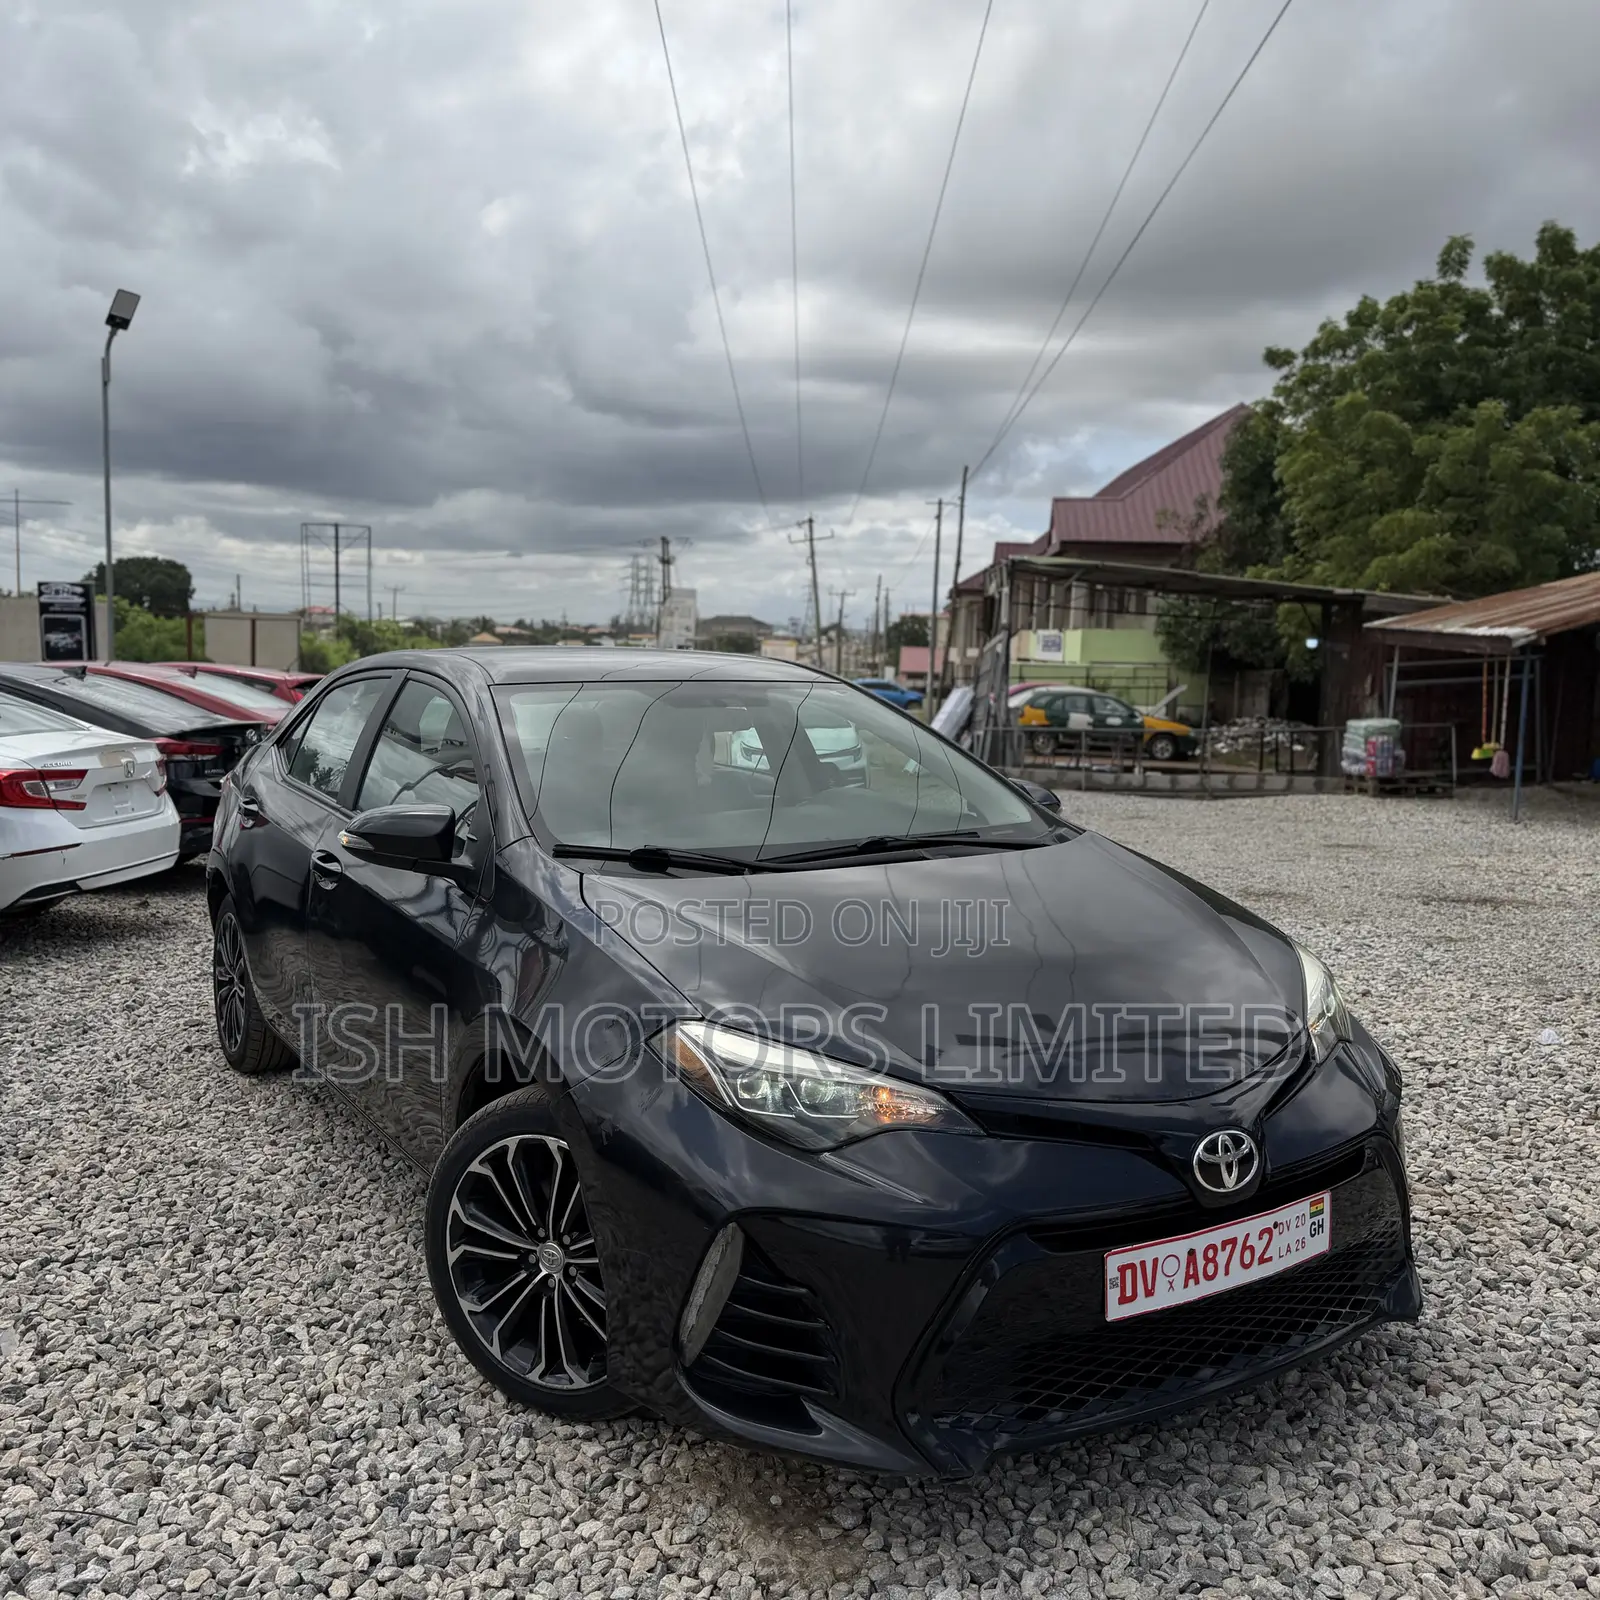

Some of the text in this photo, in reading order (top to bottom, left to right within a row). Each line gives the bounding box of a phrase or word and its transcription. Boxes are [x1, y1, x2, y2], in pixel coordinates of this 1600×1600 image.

[1278, 1212, 1306, 1236] DV 20
[1309, 1217, 1325, 1239] GH
[1278, 1236, 1306, 1259] LA 26
[1117, 1226, 1274, 1306] DV A8762
